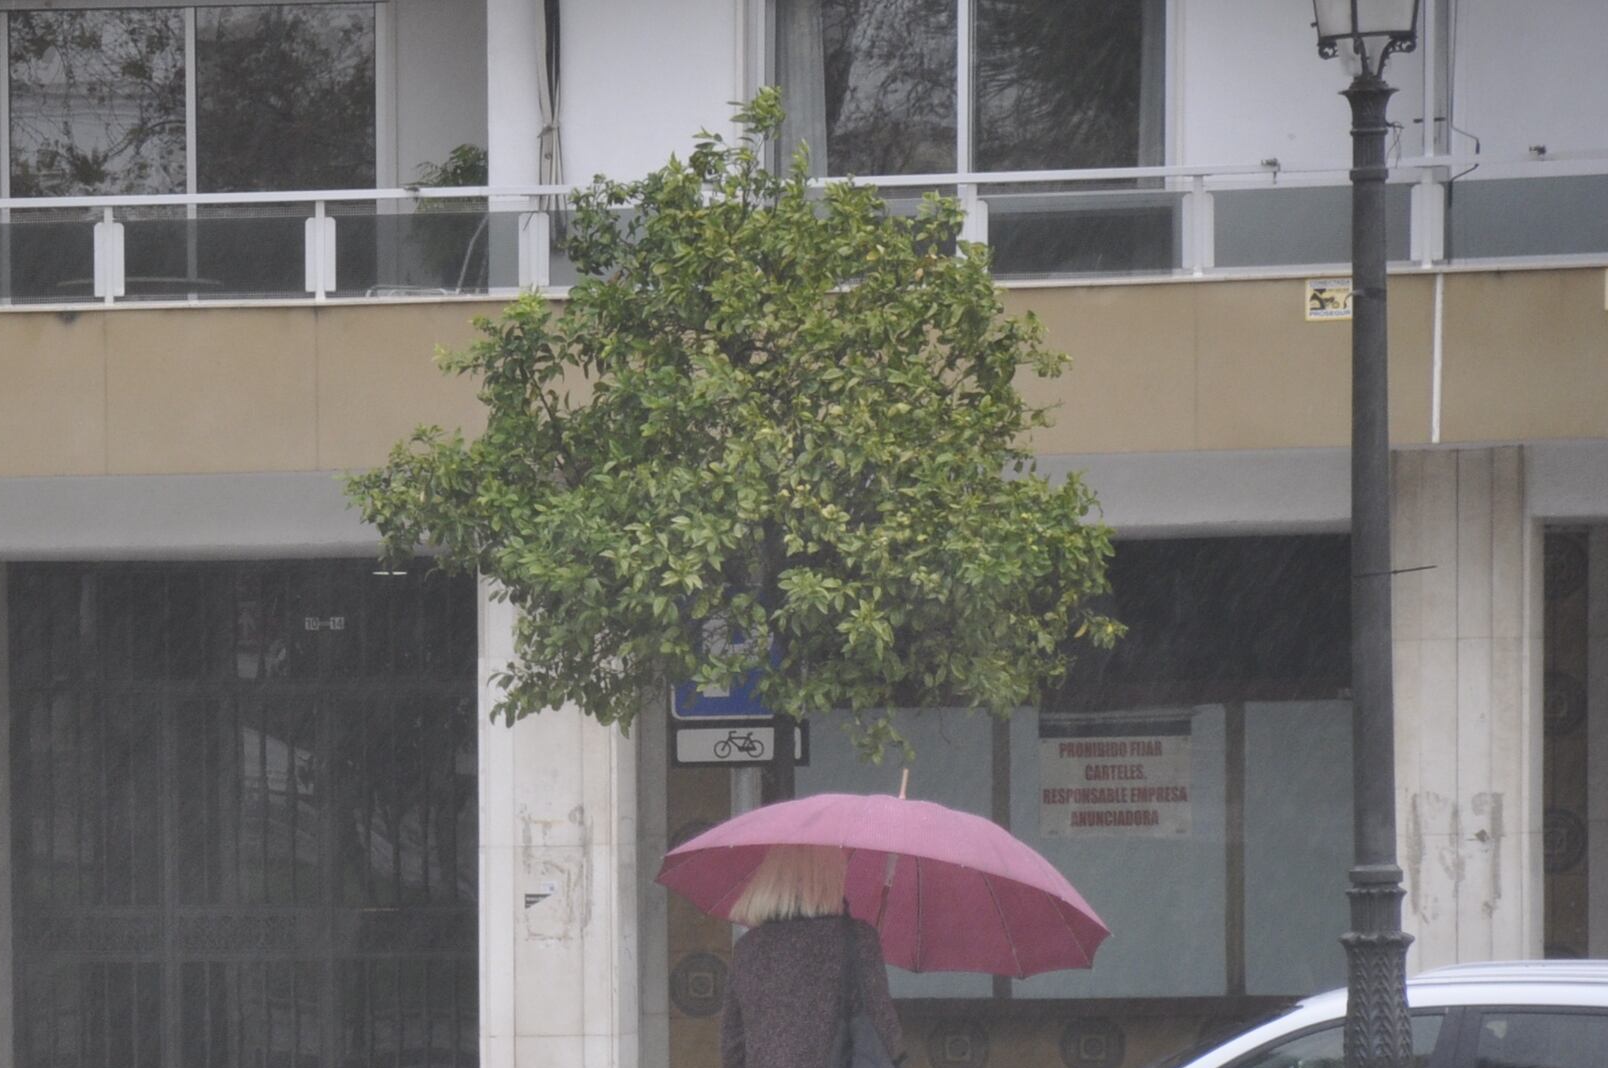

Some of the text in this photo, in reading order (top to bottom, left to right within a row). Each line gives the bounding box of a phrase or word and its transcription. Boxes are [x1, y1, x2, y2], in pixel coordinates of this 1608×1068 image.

[1059, 741, 1162, 758] PROHIBIDO FIJAR
[1043, 786, 1188, 804] RESPONSABLE EMPRESA
[1071, 810, 1160, 827] ANUNCIADORA
